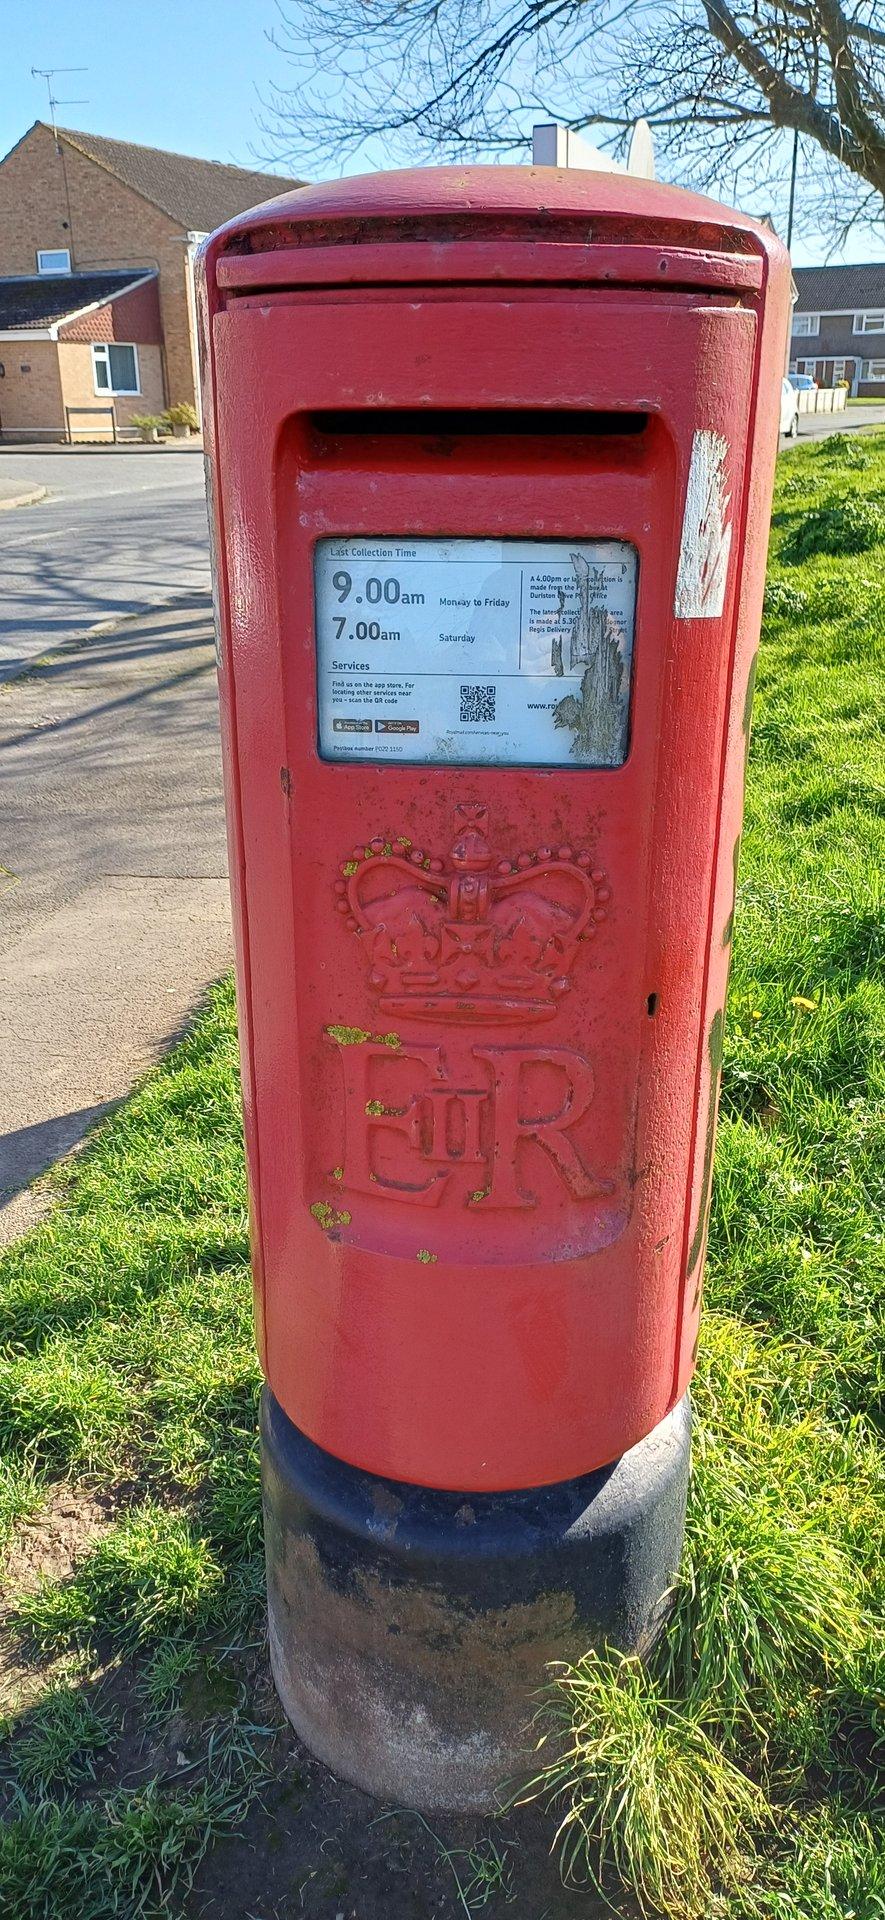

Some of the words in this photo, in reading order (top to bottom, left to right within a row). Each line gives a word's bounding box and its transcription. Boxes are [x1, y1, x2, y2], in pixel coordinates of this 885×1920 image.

[330, 548, 349, 557] Last
[352, 549, 393, 557] Collection
[395, 549, 417, 557] Time
[332, 570, 425, 605] 9.00am
[485, 598, 510, 607] Friday
[332, 616, 401, 640] 7.00am
[439, 633, 476, 643] Saturday
[332, 661, 370, 671] Services
